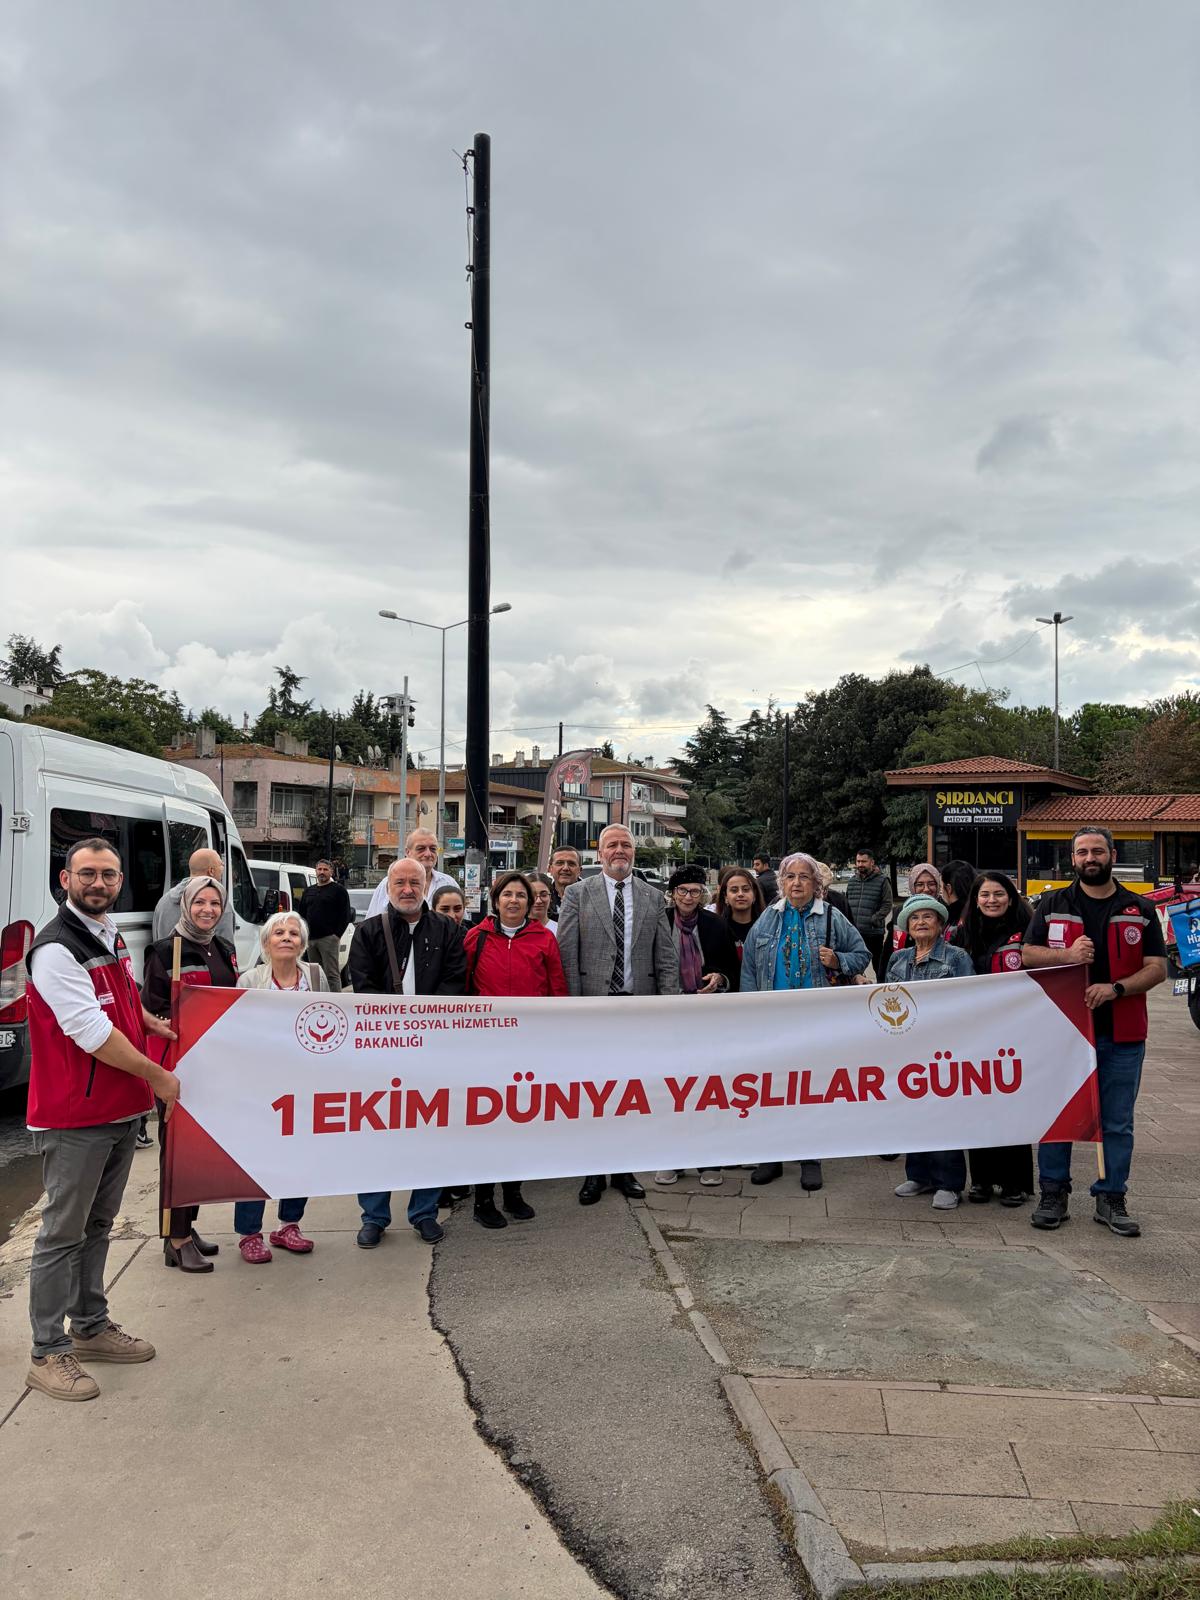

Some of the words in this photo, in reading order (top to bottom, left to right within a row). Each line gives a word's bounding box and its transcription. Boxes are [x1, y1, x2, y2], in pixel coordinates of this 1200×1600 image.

[935, 791, 1014, 809] ŞIRDANCI
[983, 805, 1003, 814] YERİ
[354, 1003, 407, 1016] TÜRKİYE
[409, 1003, 493, 1015] CUMHURİYETİ
[354, 1020, 382, 1032] AİLE
[384, 1020, 401, 1031] VE
[403, 1019, 450, 1031] SOSYAL
[452, 1016, 519, 1030] HİZMETLER
[354, 1034, 424, 1049] BAKANLIĞI
[271, 1094, 295, 1136] 1
[313, 1077, 449, 1134] EKİM
[466, 1071, 651, 1126] DÜNYA
[665, 1066, 886, 1119] YAŞLILAR
[898, 1048, 1022, 1101] GÜNÜ
